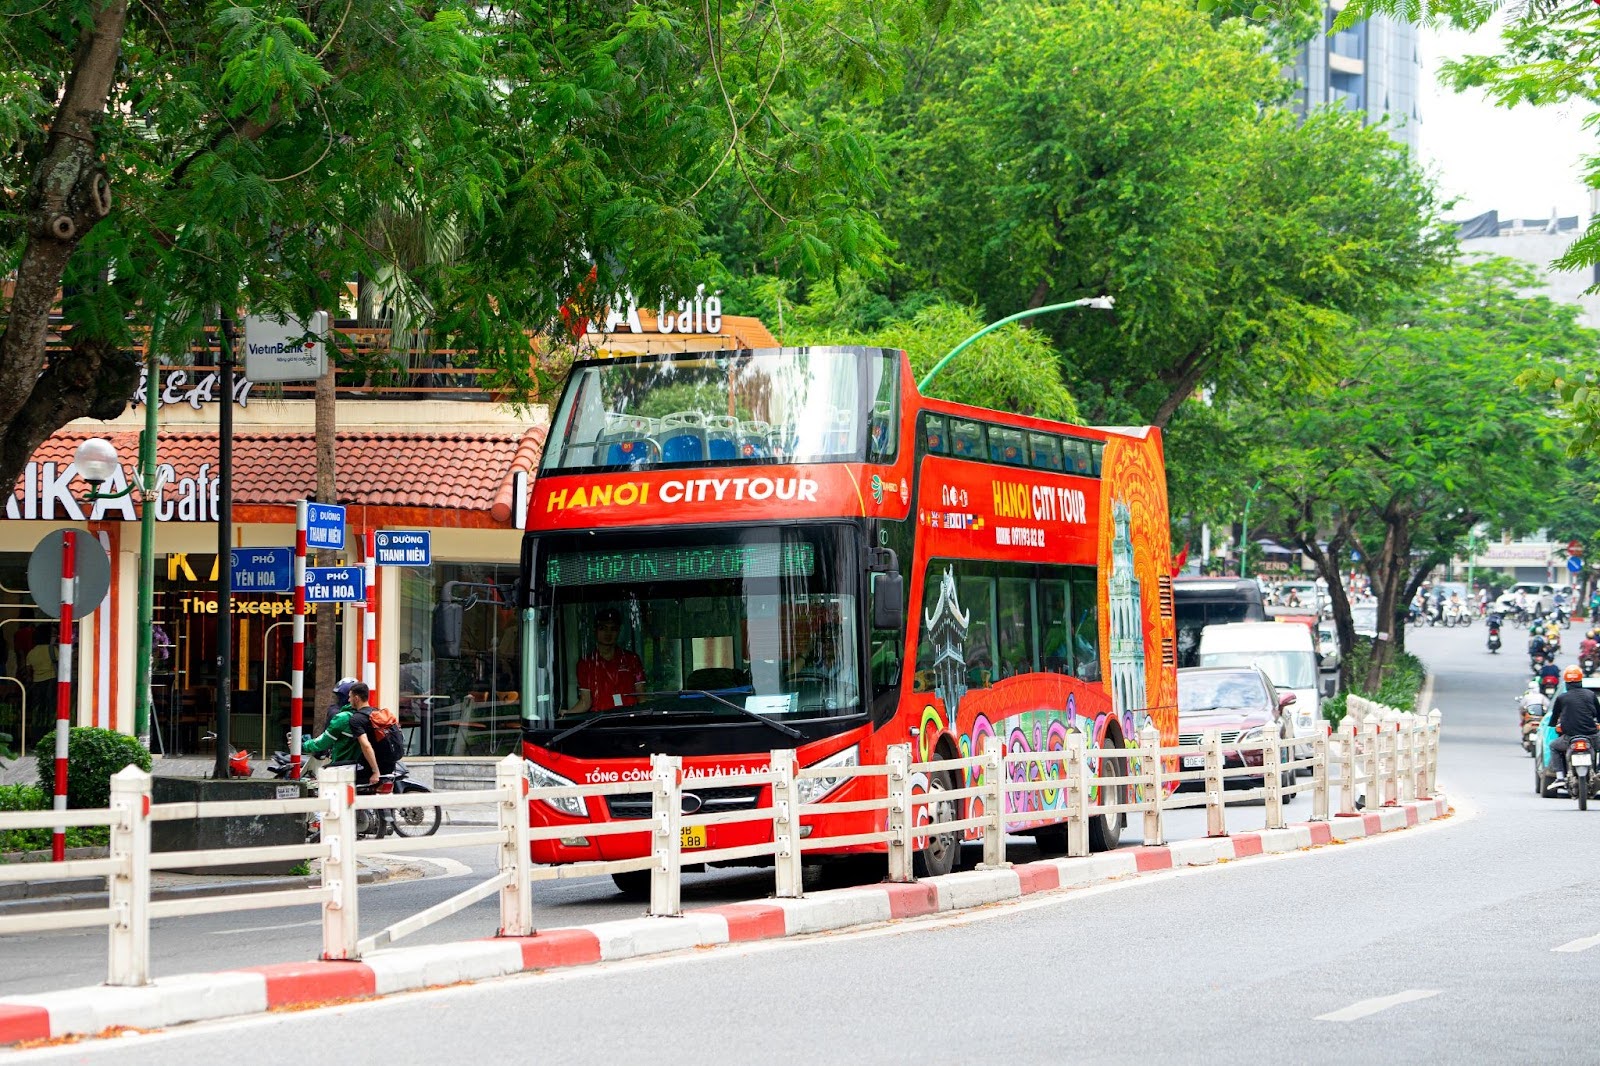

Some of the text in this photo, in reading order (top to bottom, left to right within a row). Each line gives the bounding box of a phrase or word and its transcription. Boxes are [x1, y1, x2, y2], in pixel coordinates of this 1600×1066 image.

[248, 342, 303, 355] VietinBank
[5, 462, 137, 521] IKA
[546, 481, 649, 513] HANOI
[658, 477, 819, 503] CITYTOUR
[992, 480, 1087, 525] HANOI CITY TOUR
[309, 526, 328, 543] THANH
[392, 534, 424, 544] ĐƯỜNG
[252, 551, 276, 564] PHỐ
[379, 547, 426, 562] THANH NIÊN
[587, 554, 625, 580] HOP
[630, 553, 659, 577] ON
[676, 549, 715, 575] HOP
[721, 547, 758, 574] OFF
[235, 568, 276, 587] YÊN HOA
[326, 569, 350, 580] PHỐ
[308, 583, 355, 598] YÊN HOA
[180, 597, 218, 614] The
[585, 766, 619, 783] TỔNG
[729, 764, 747, 776] HÀ
